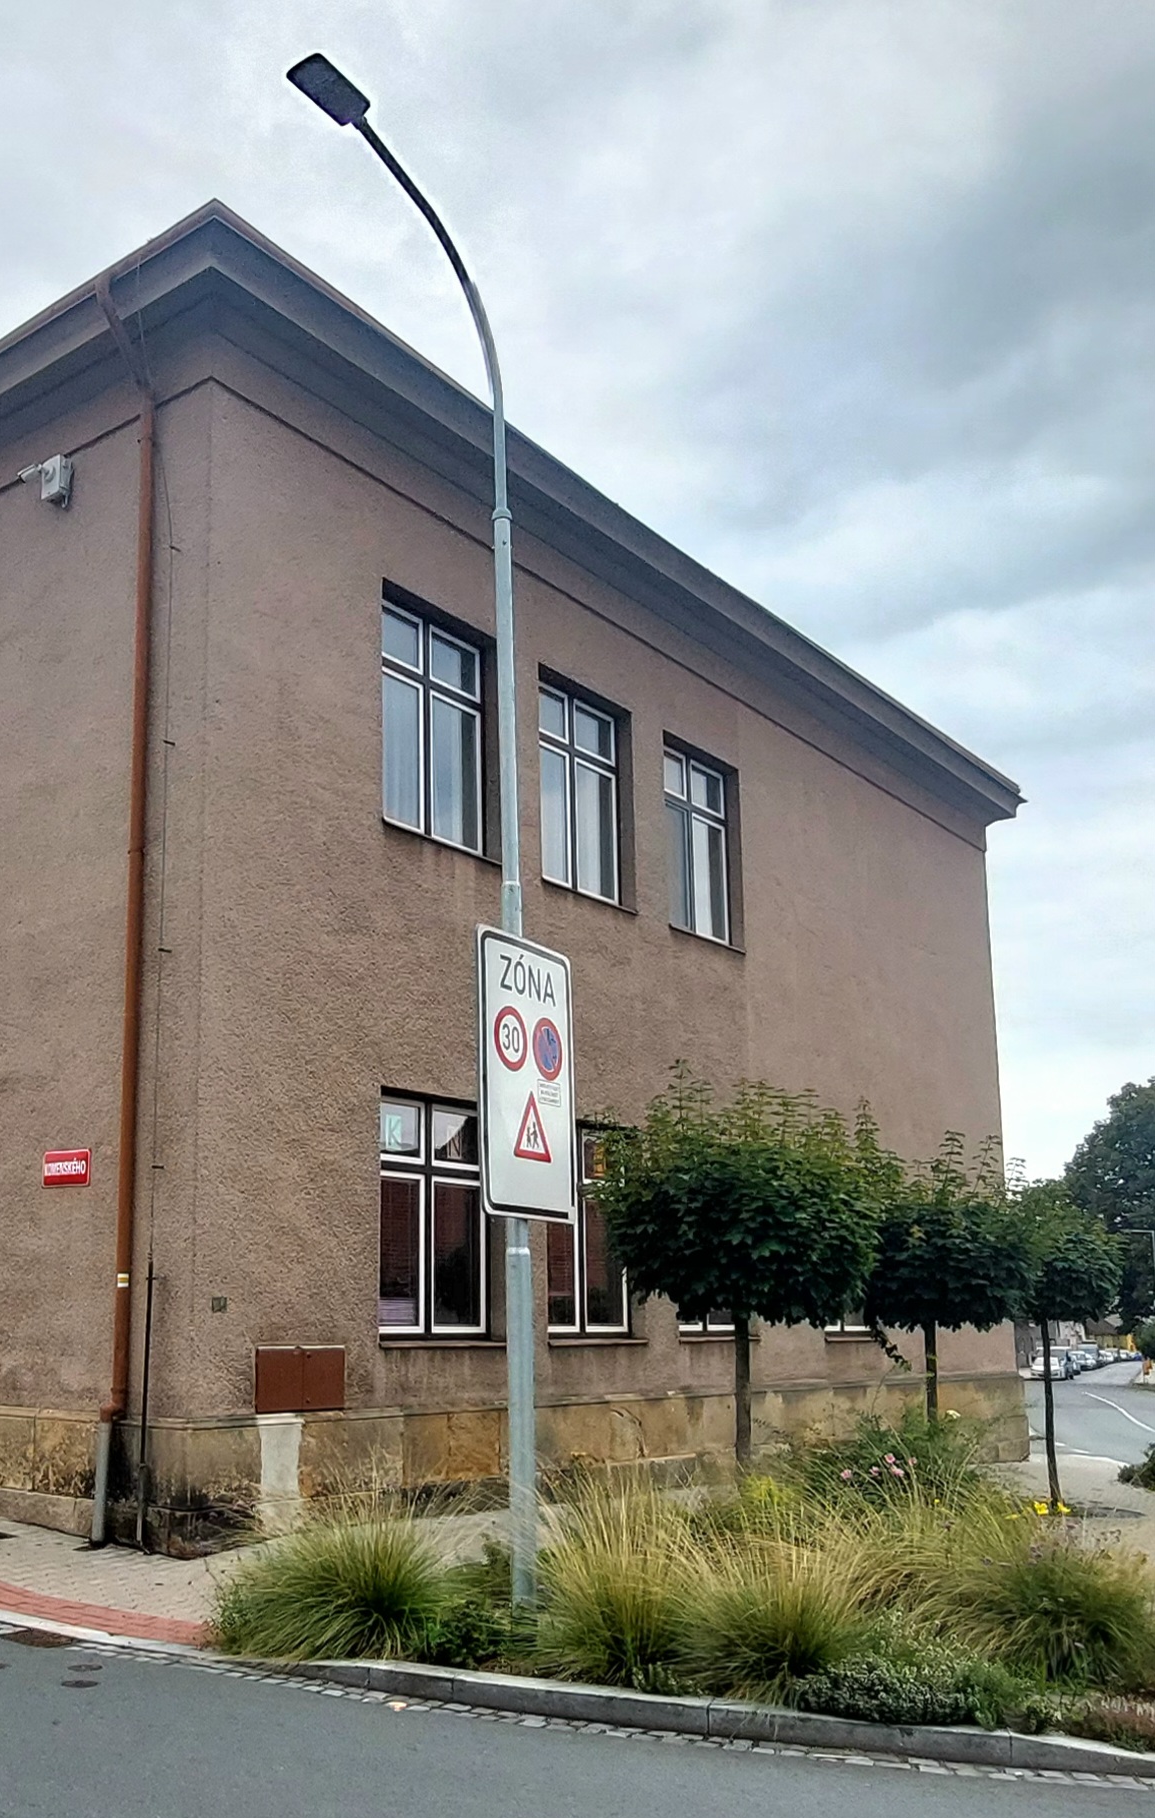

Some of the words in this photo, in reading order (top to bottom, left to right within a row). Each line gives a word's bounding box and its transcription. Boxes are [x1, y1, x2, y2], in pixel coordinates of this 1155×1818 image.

[500, 953, 556, 1008] ZÓNA
[502, 1023, 520, 1054] 30
[388, 1116, 403, 1147] K
